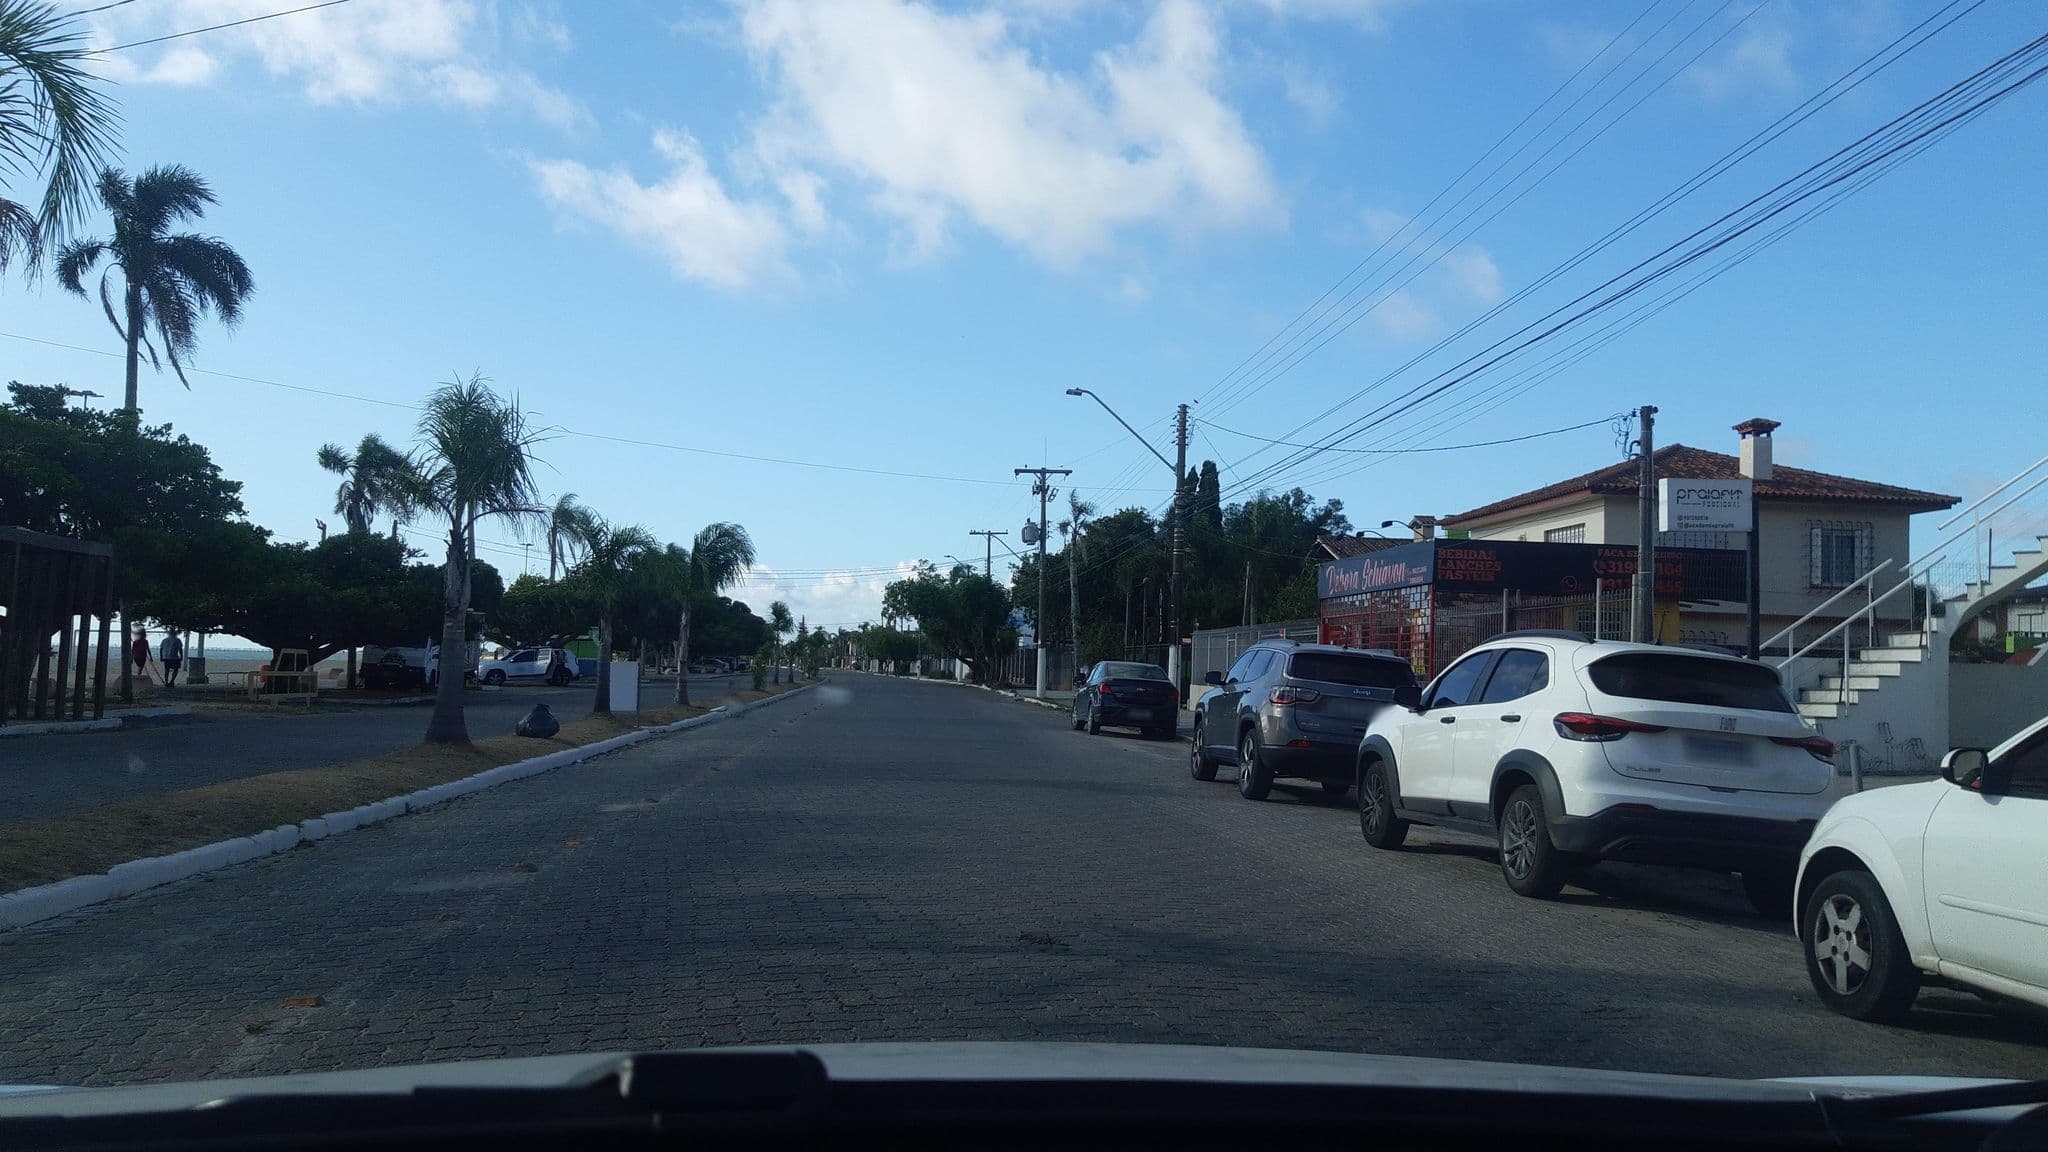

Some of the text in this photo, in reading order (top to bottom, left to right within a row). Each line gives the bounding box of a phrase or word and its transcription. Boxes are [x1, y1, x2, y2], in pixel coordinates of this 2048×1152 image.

[1437, 549, 1497, 560] BEBIDAS
[1437, 559, 1502, 571] LANCHES
[1437, 570, 1495, 581] PASTEIS
